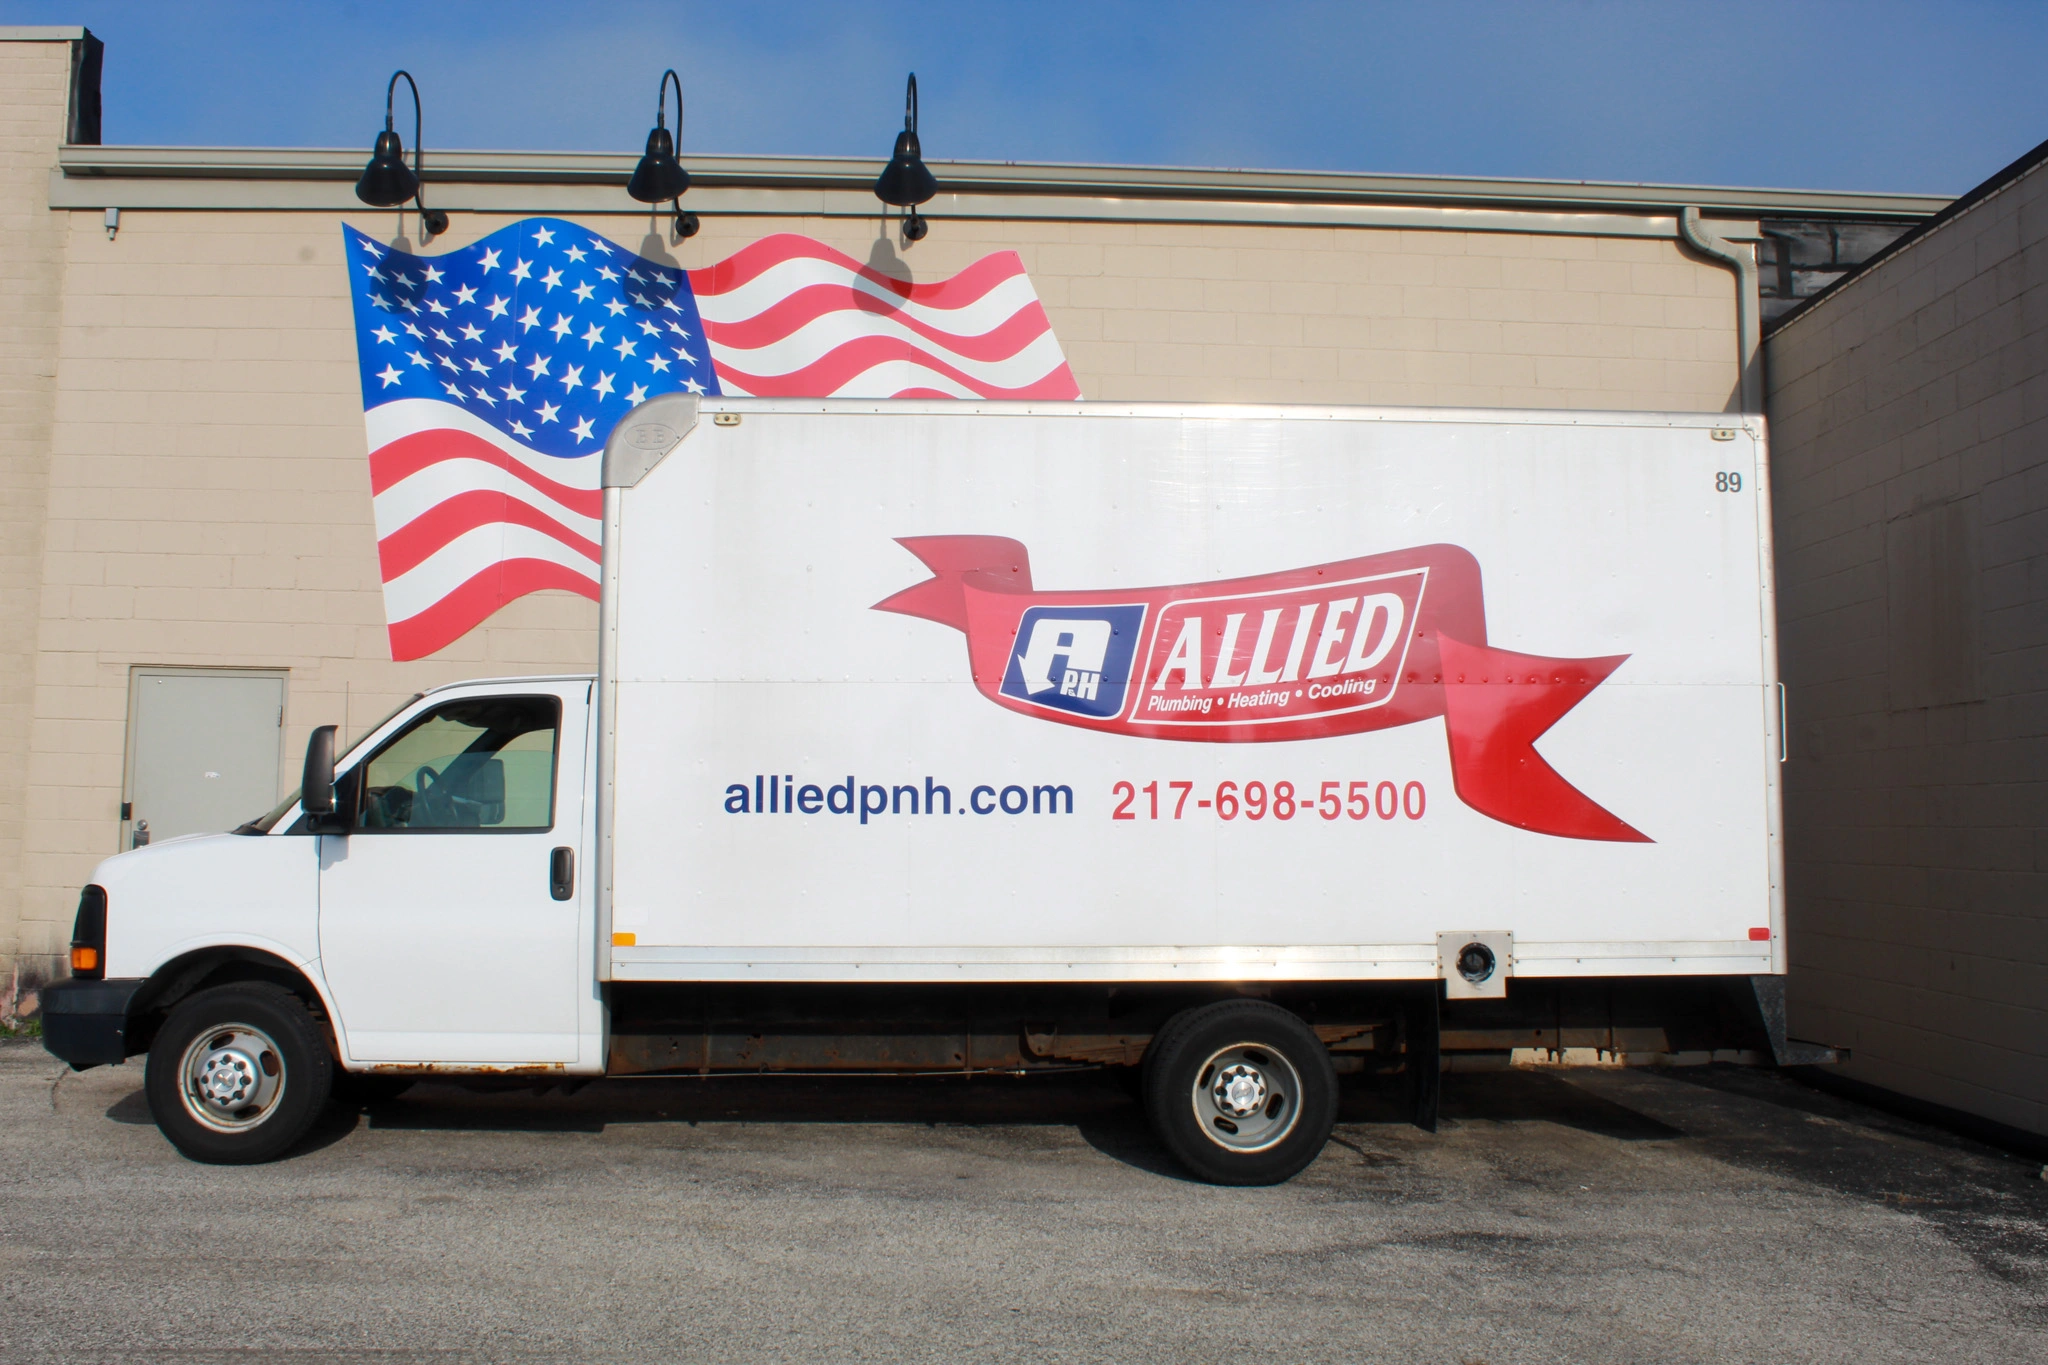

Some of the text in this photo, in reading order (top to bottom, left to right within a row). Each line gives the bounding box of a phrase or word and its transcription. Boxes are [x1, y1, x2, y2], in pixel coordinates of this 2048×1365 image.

[1715, 471, 1742, 493] 89
[1151, 592, 1404, 691] ALLIED
[1147, 677, 1377, 714] Plumbing Heating Cooling
[724, 774, 1074, 825] alliedpnh.com
[1111, 779, 1427, 821] 217-698-5500
